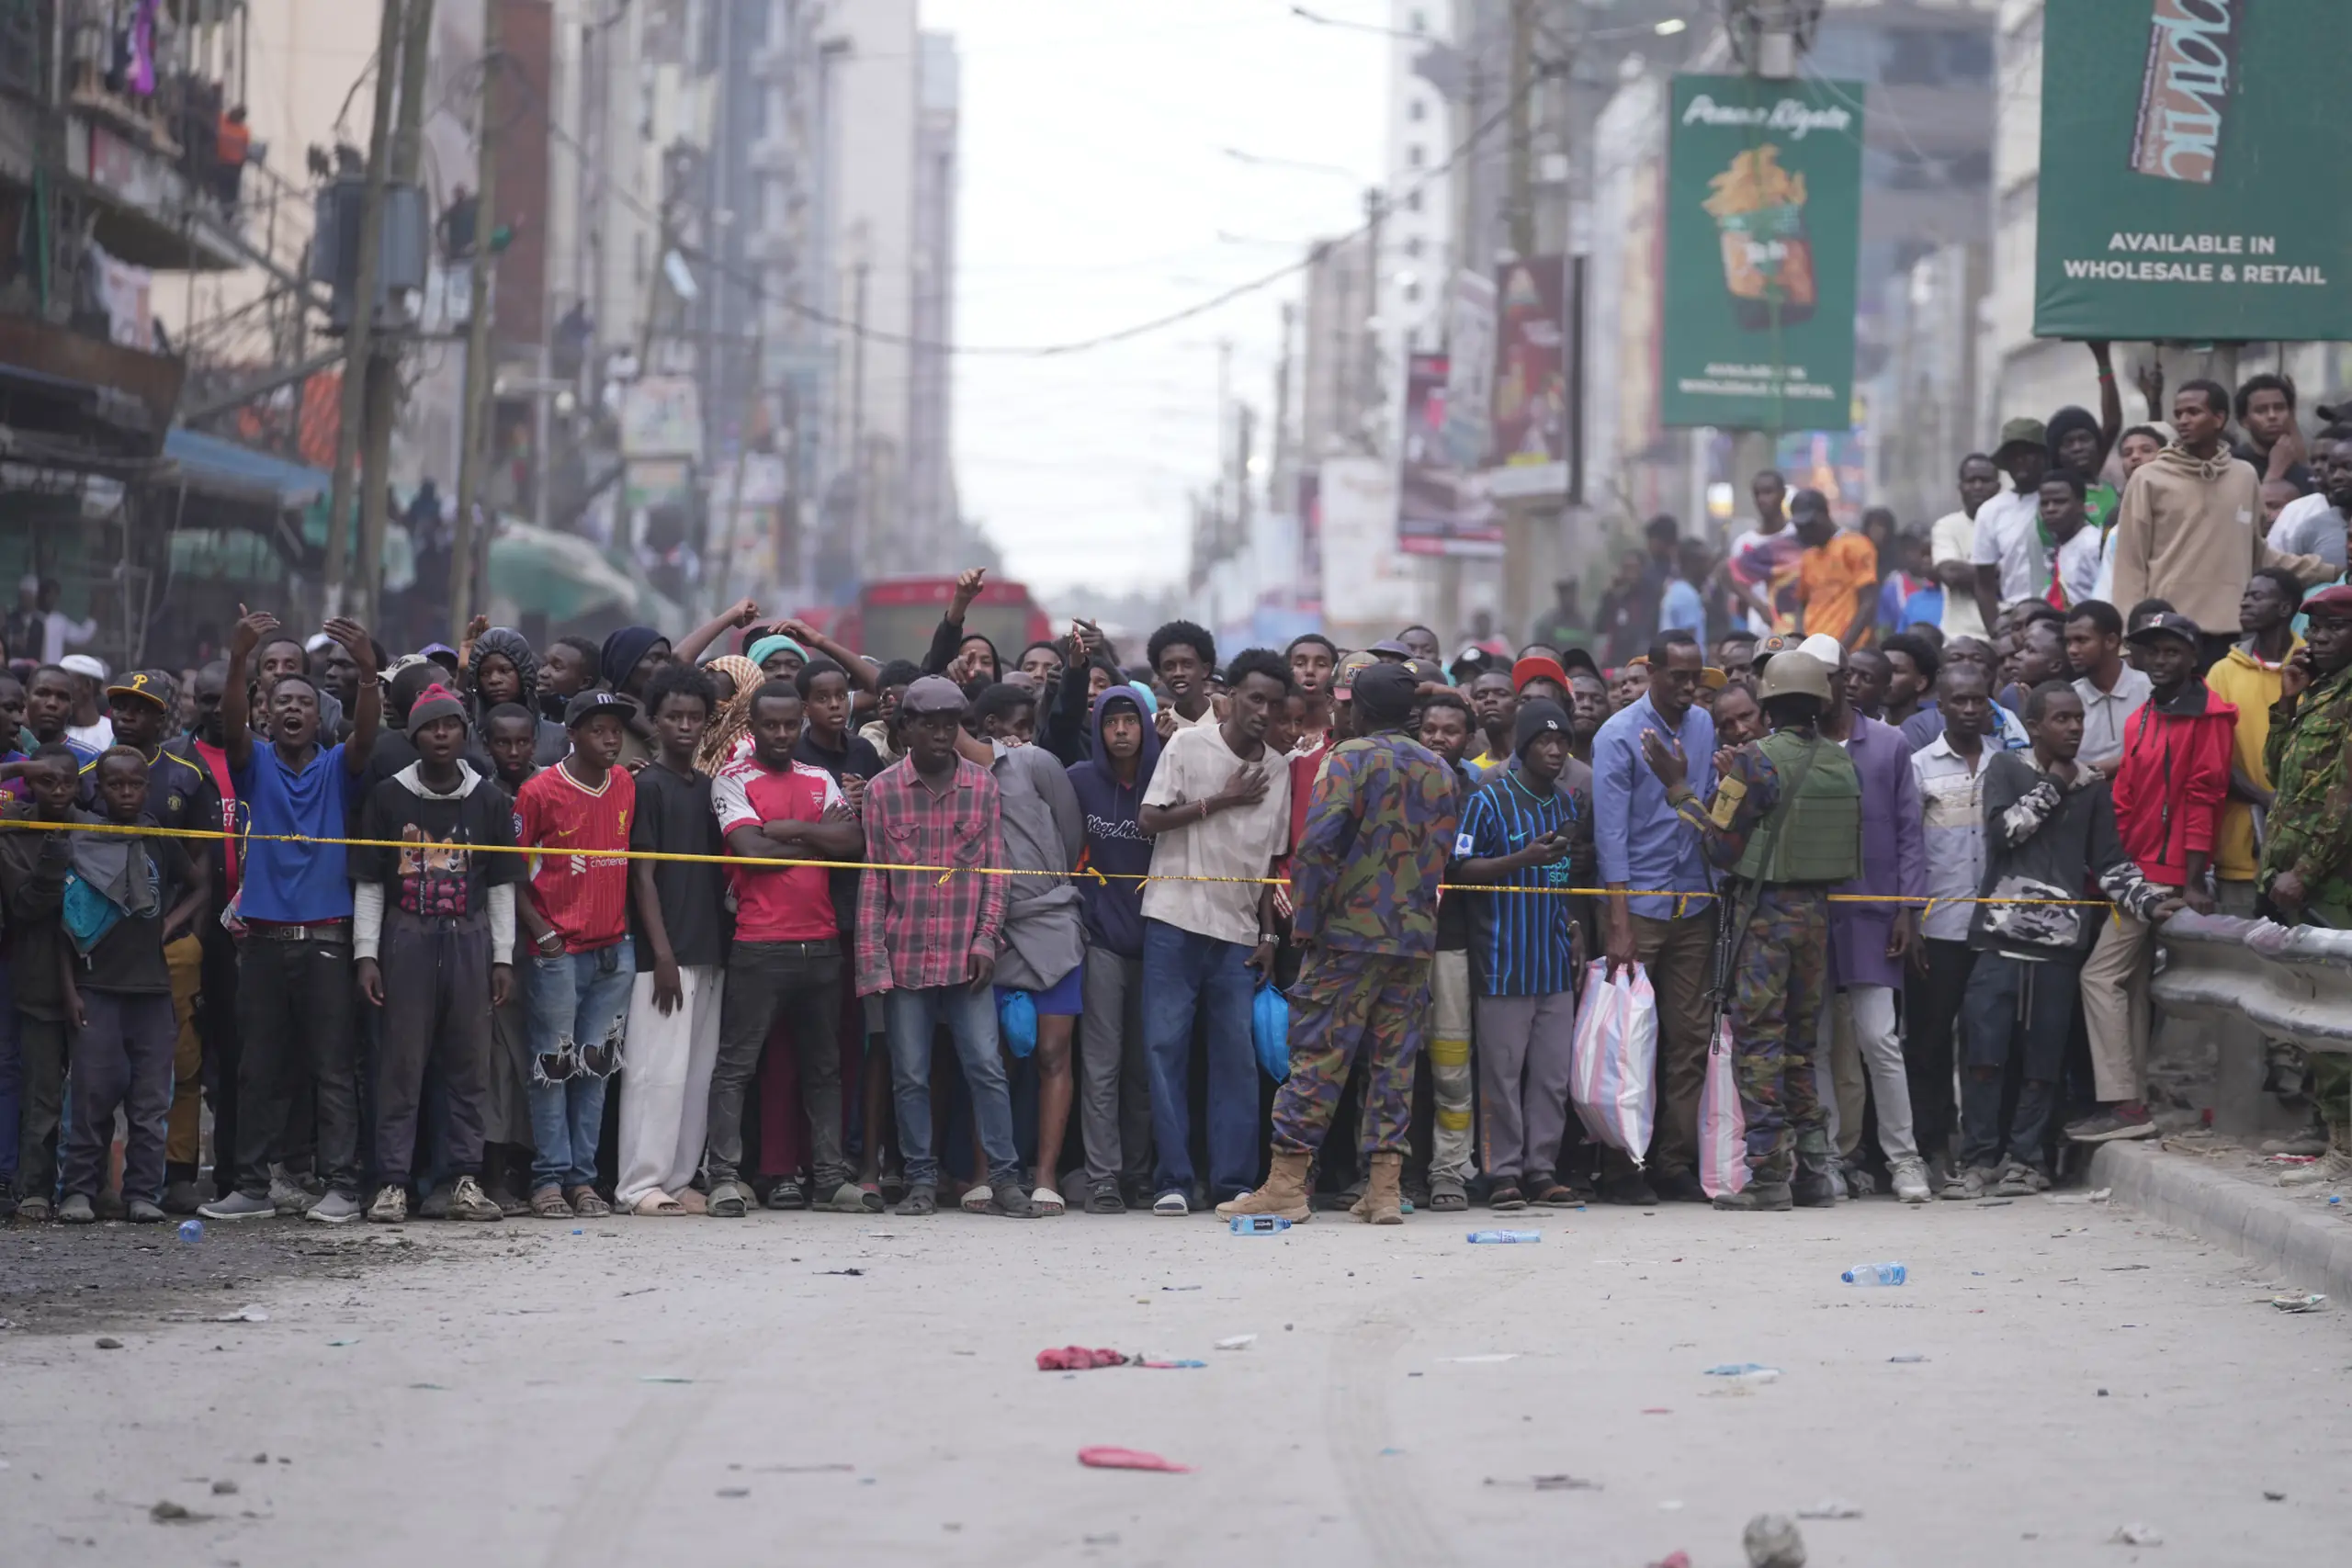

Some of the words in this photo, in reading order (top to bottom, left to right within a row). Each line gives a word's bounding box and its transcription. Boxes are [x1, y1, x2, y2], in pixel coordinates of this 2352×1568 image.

[2108, 232, 2243, 254] AVAILABLE
[2250, 236, 2276, 254] IN
[2064, 260, 2213, 282] WHOLESALE
[2220, 265, 2236, 282] &
[2243, 265, 2327, 285] RETAIL
